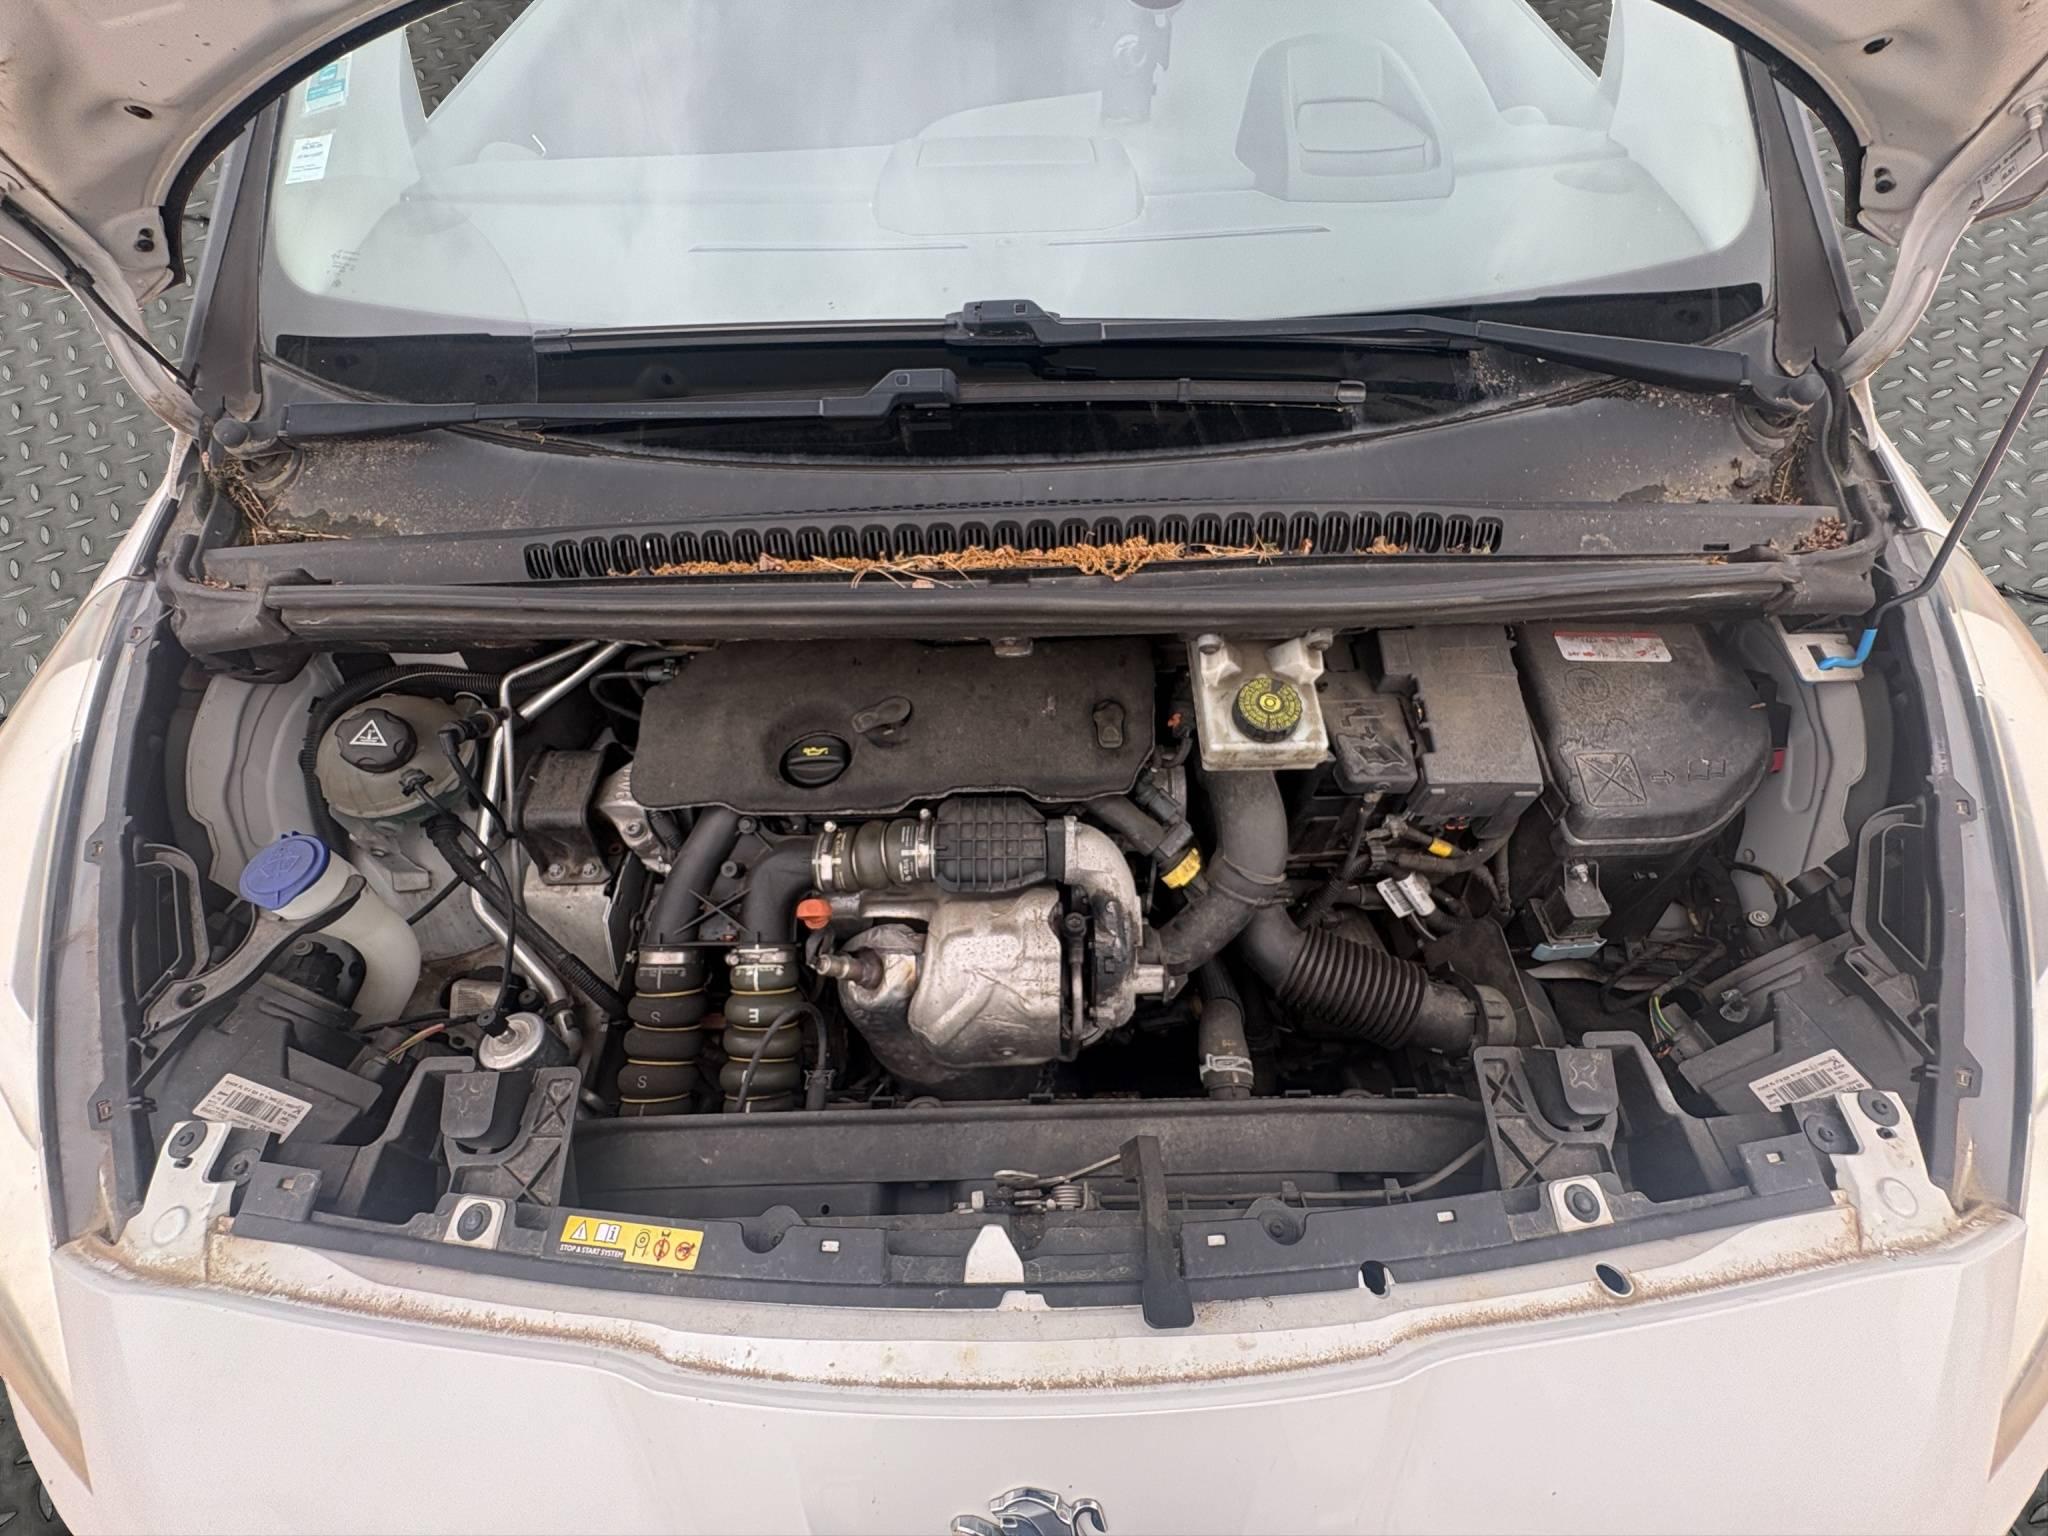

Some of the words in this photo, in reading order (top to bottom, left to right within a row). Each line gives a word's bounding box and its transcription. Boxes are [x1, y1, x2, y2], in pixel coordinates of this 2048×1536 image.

[637, 1076, 648, 1088] S
[560, 1243, 576, 1252] STOP
[582, 1246, 601, 1255] START
[600, 1248, 624, 1258] SYSTEM
